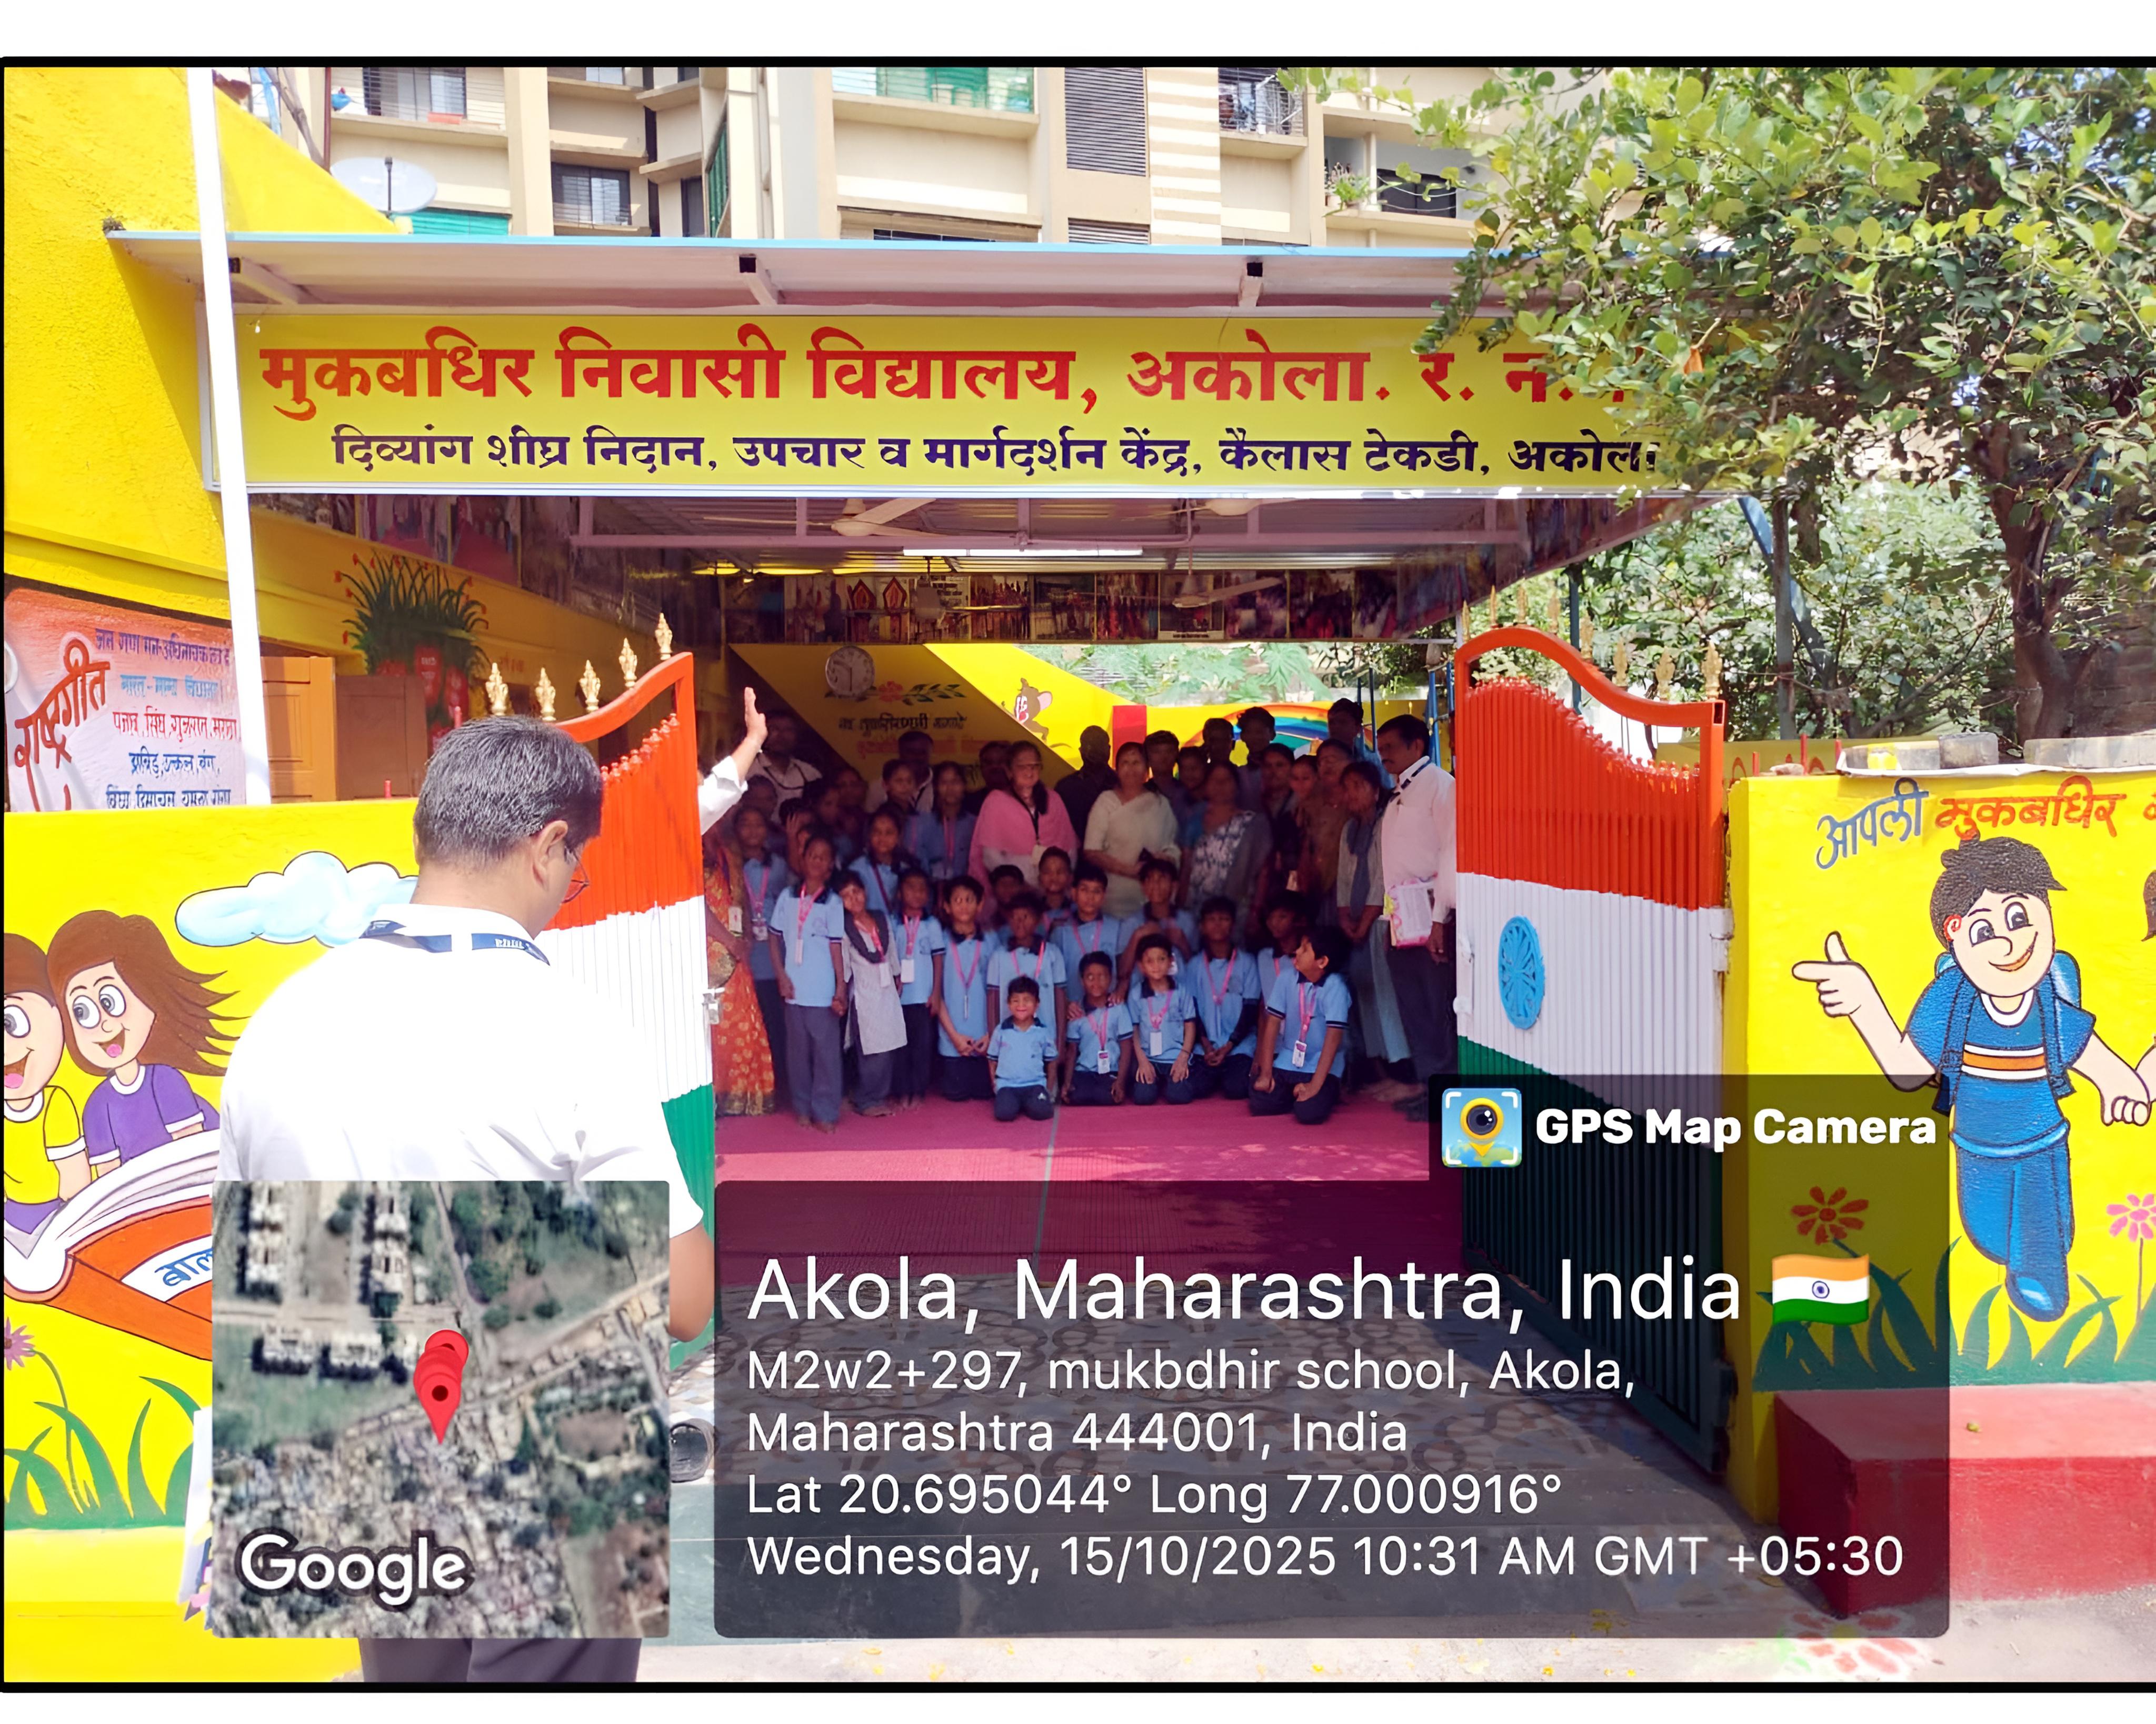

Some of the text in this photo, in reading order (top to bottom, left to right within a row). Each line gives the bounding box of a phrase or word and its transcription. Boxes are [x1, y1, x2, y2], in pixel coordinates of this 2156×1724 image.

[259, 326, 535, 421] मुकबधिर
[554, 323, 786, 399] निवासी
[806, 326, 1097, 415] विद्यालय,
[1127, 327, 1391, 402] अकोला.
[1418, 352, 1474, 402] र.
[331, 424, 473, 472] दिव्यांग
[487, 424, 571, 468] शीघ्र
[583, 424, 717, 474] निदान,
[732, 437, 865, 469] उपचार
[878, 438, 911, 468] व
[923, 425, 1107, 477] मार्गदर्शन
[1120, 426, 1202, 477] केंद्र,
[1218, 427, 1352, 472] कैलास
[1363, 428, 1490, 476] टेकडी,
[1816, 777, 1929, 869] आपली
[1935, 776, 2127, 841] मुकबधिर
